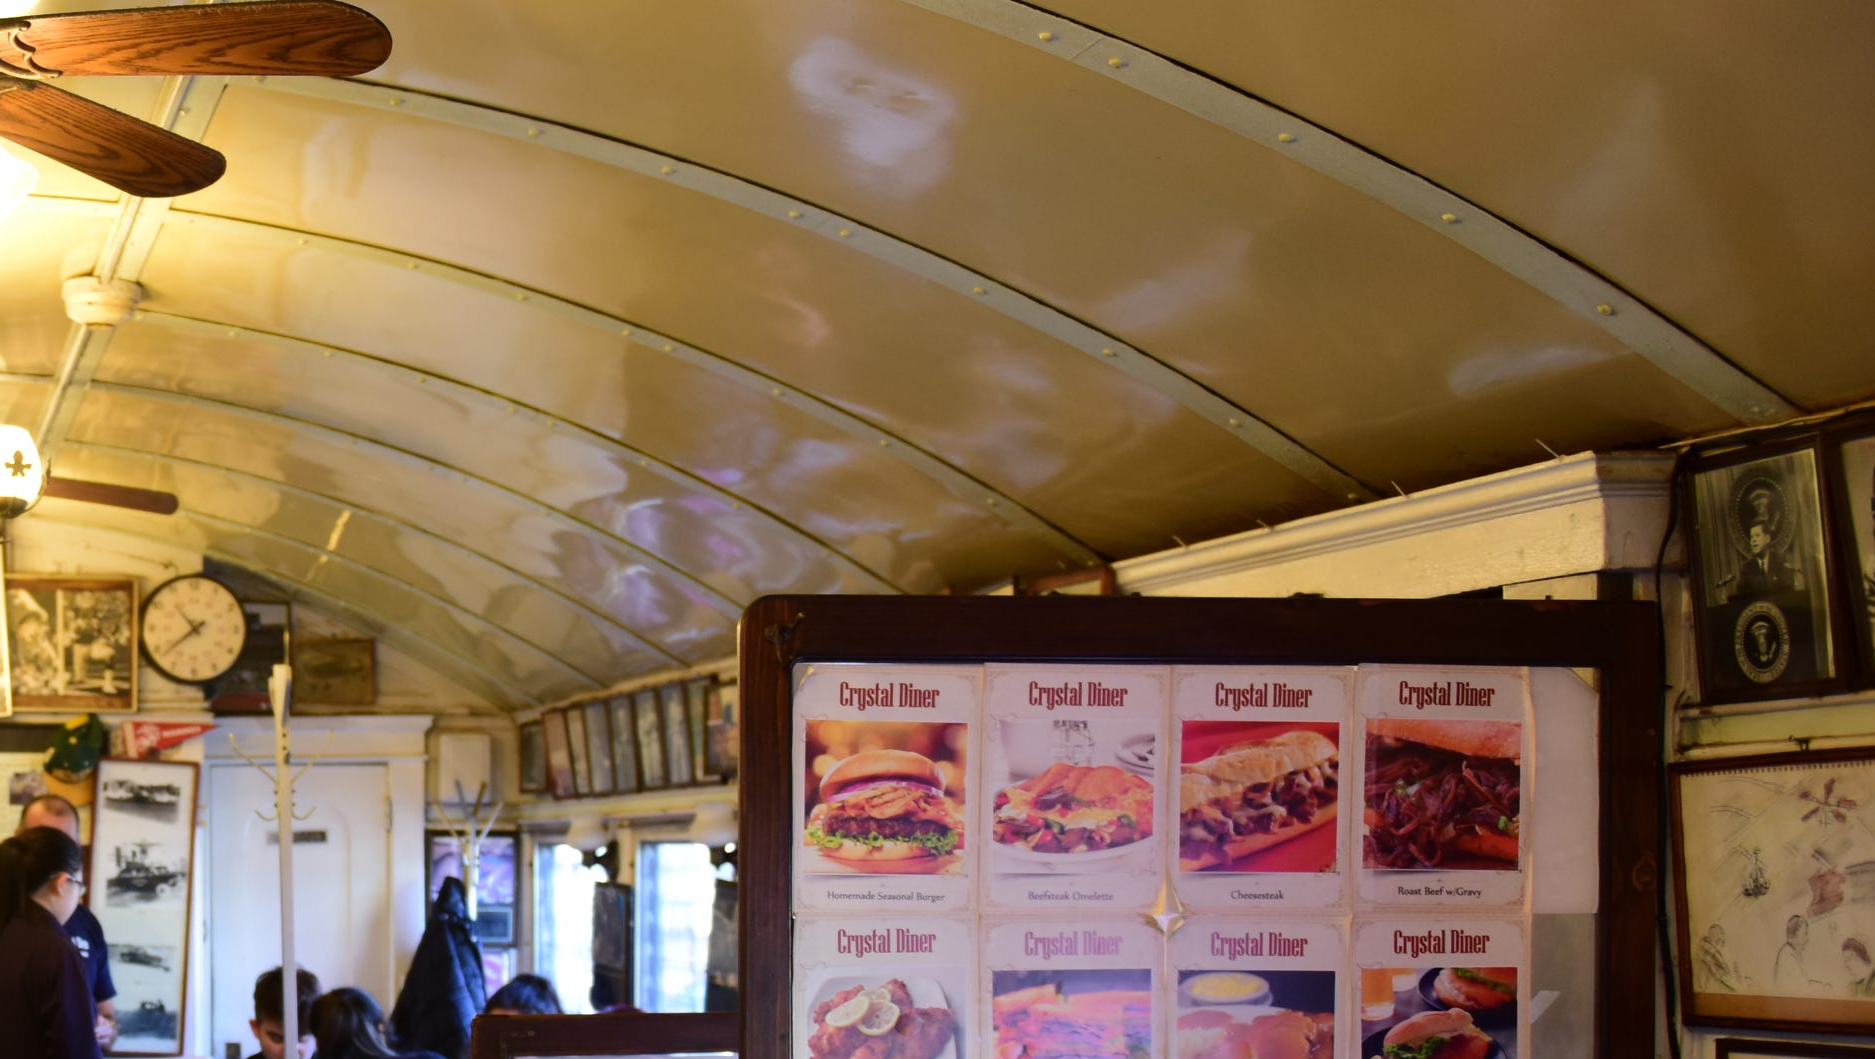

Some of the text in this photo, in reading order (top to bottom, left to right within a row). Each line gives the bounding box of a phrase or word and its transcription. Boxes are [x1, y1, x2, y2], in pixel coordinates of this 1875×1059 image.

[840, 682, 940, 711] Crystal Diner
[1029, 681, 1128, 710] Crystal Diner
[1215, 682, 1313, 711] Crystal Diner
[1399, 681, 1495, 710] Crystal Diner
[827, 890, 945, 903] Homemade Seasonal Burger
[1028, 890, 1114, 902] Beefsteak Omelette
[1231, 890, 1285, 901] Cheesesteak
[1397, 886, 1482, 898] Roast Beef w/Gravy
[837, 929, 937, 958] Crystal Diner
[1025, 931, 1123, 960] Crystal Diner
[1211, 932, 1308, 960] Crystal Diner
[1393, 929, 1490, 958] Crystal Diner
